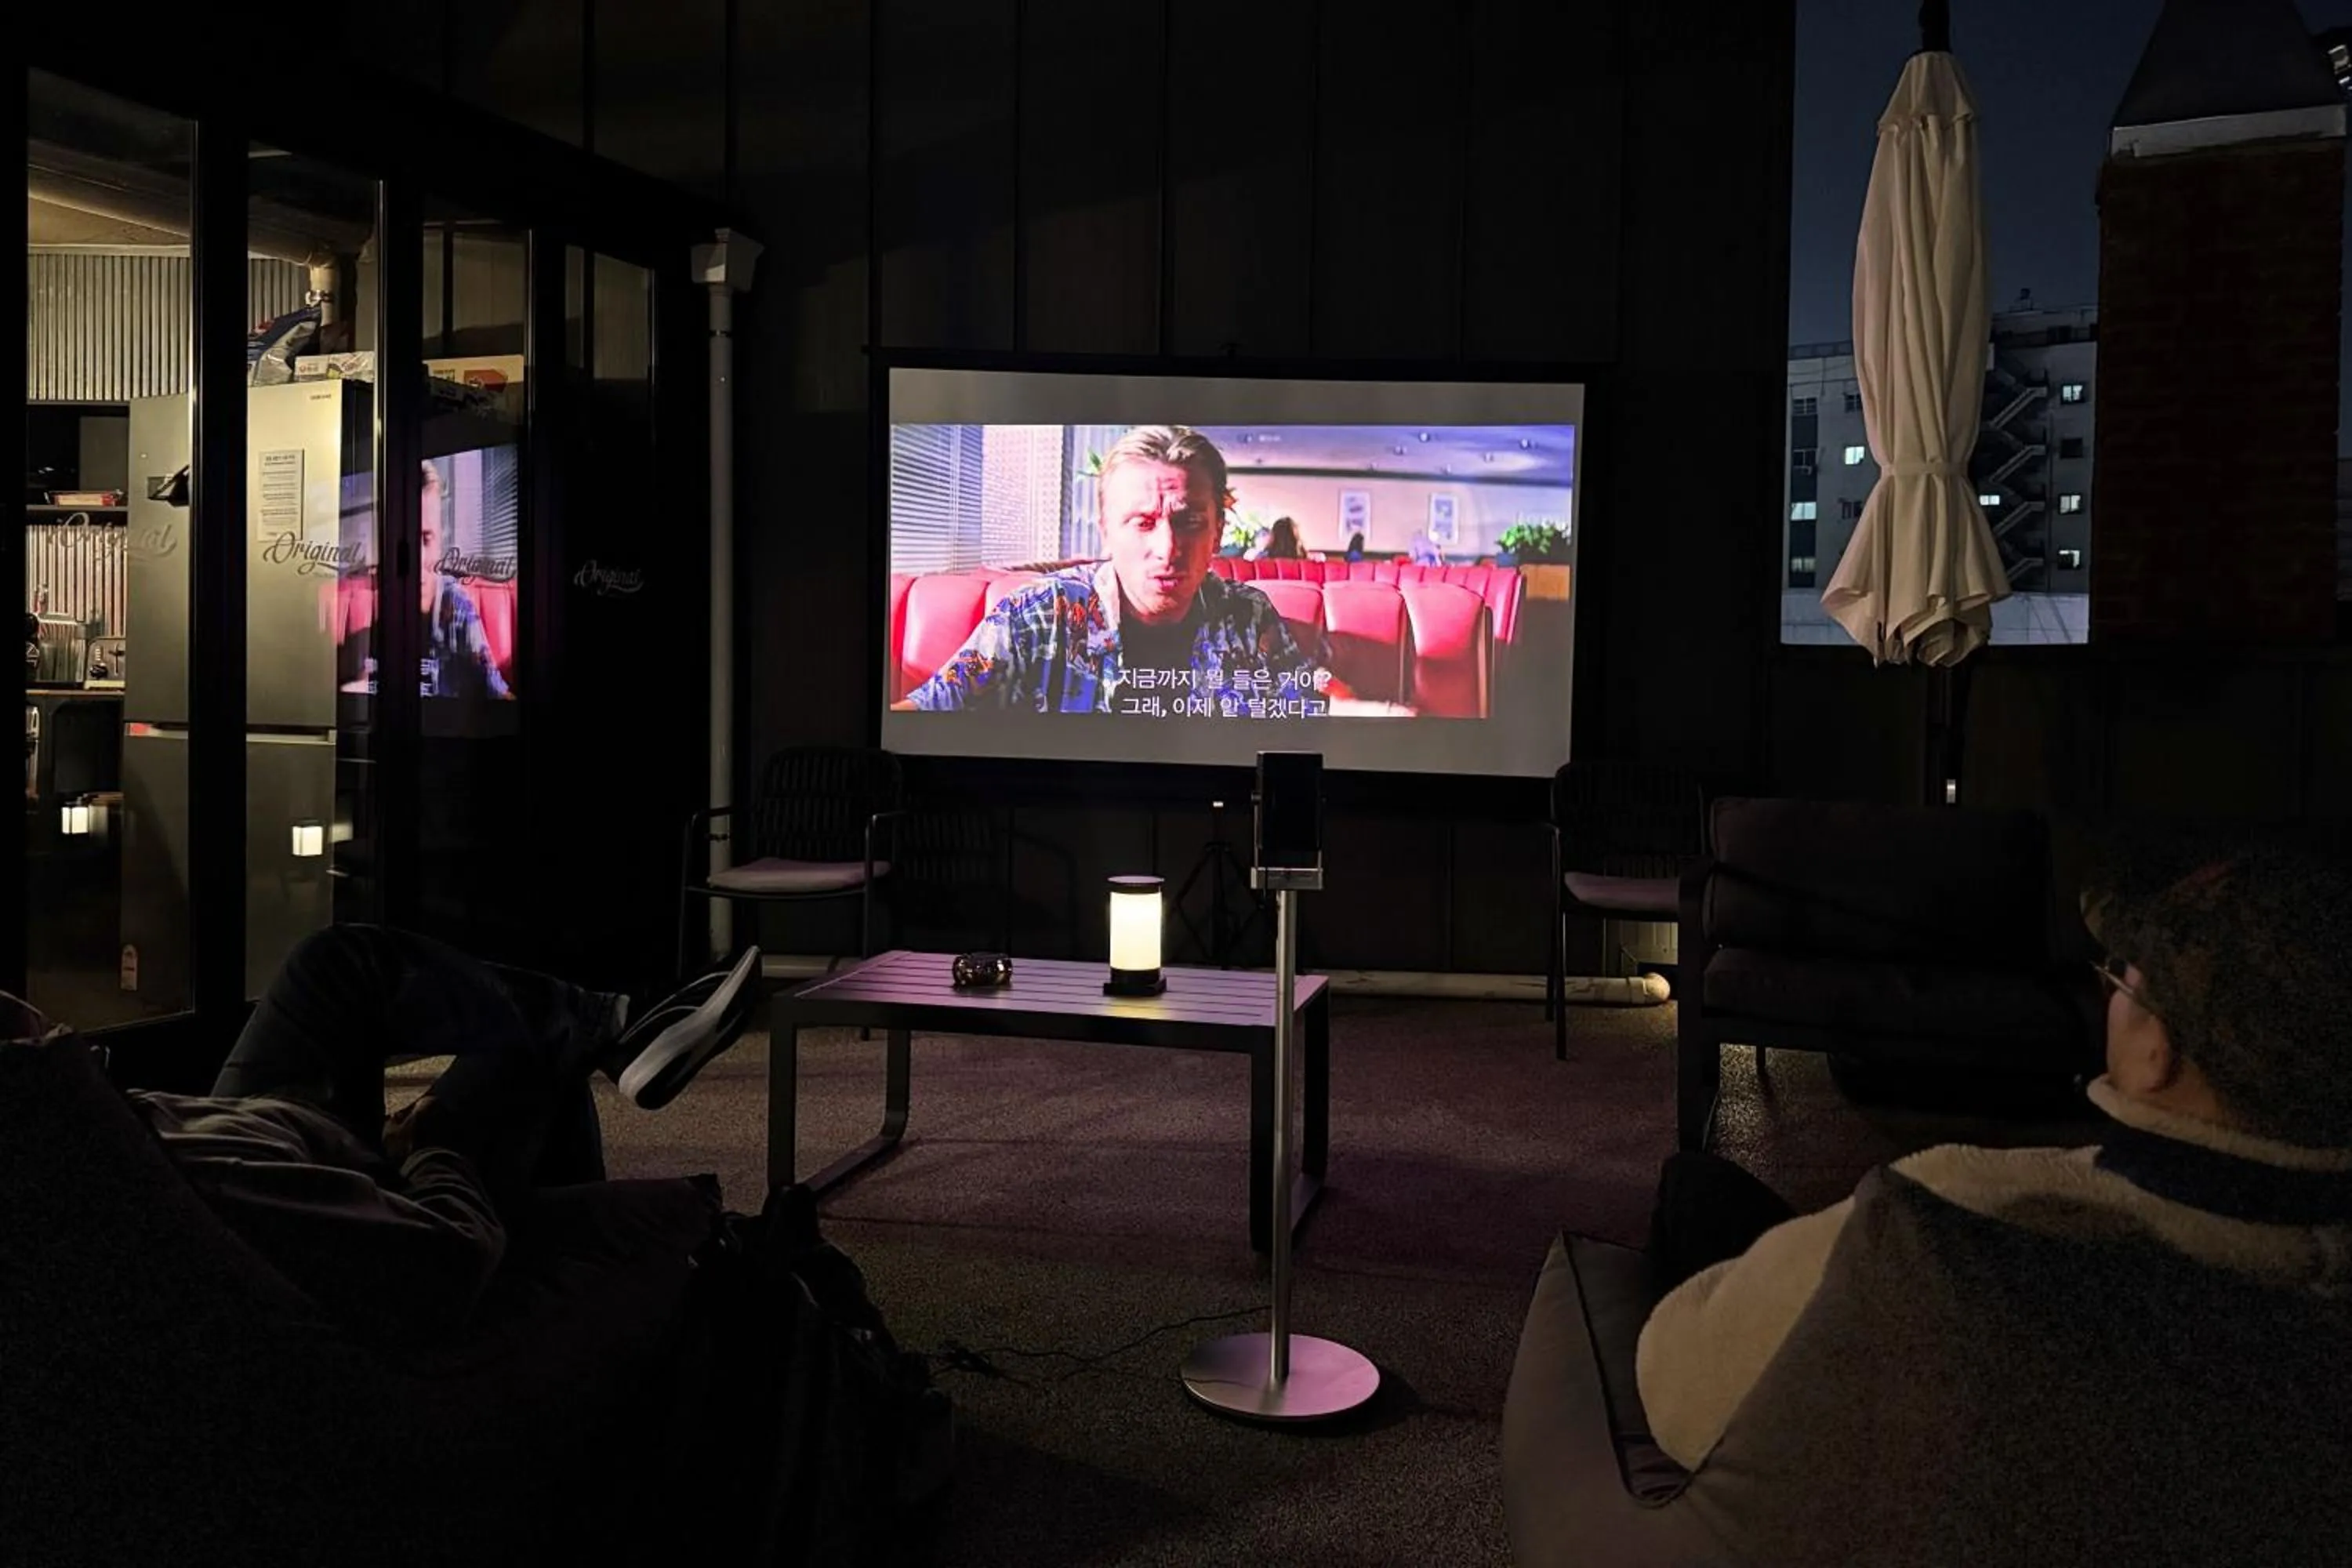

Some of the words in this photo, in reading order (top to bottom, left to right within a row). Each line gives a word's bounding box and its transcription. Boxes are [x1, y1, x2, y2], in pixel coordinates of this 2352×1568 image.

[263, 531, 365, 575] Original
[434, 547, 517, 585] Original
[573, 559, 644, 596] Original
[1118, 668, 1196, 689] 지금까지
[1232, 669, 1272, 690] 들은
[1120, 696, 1167, 717] 그래,
[1173, 697, 1211, 717] 이제
[1221, 697, 1239, 717] 안
[1248, 697, 1328, 719] 털겠다고
